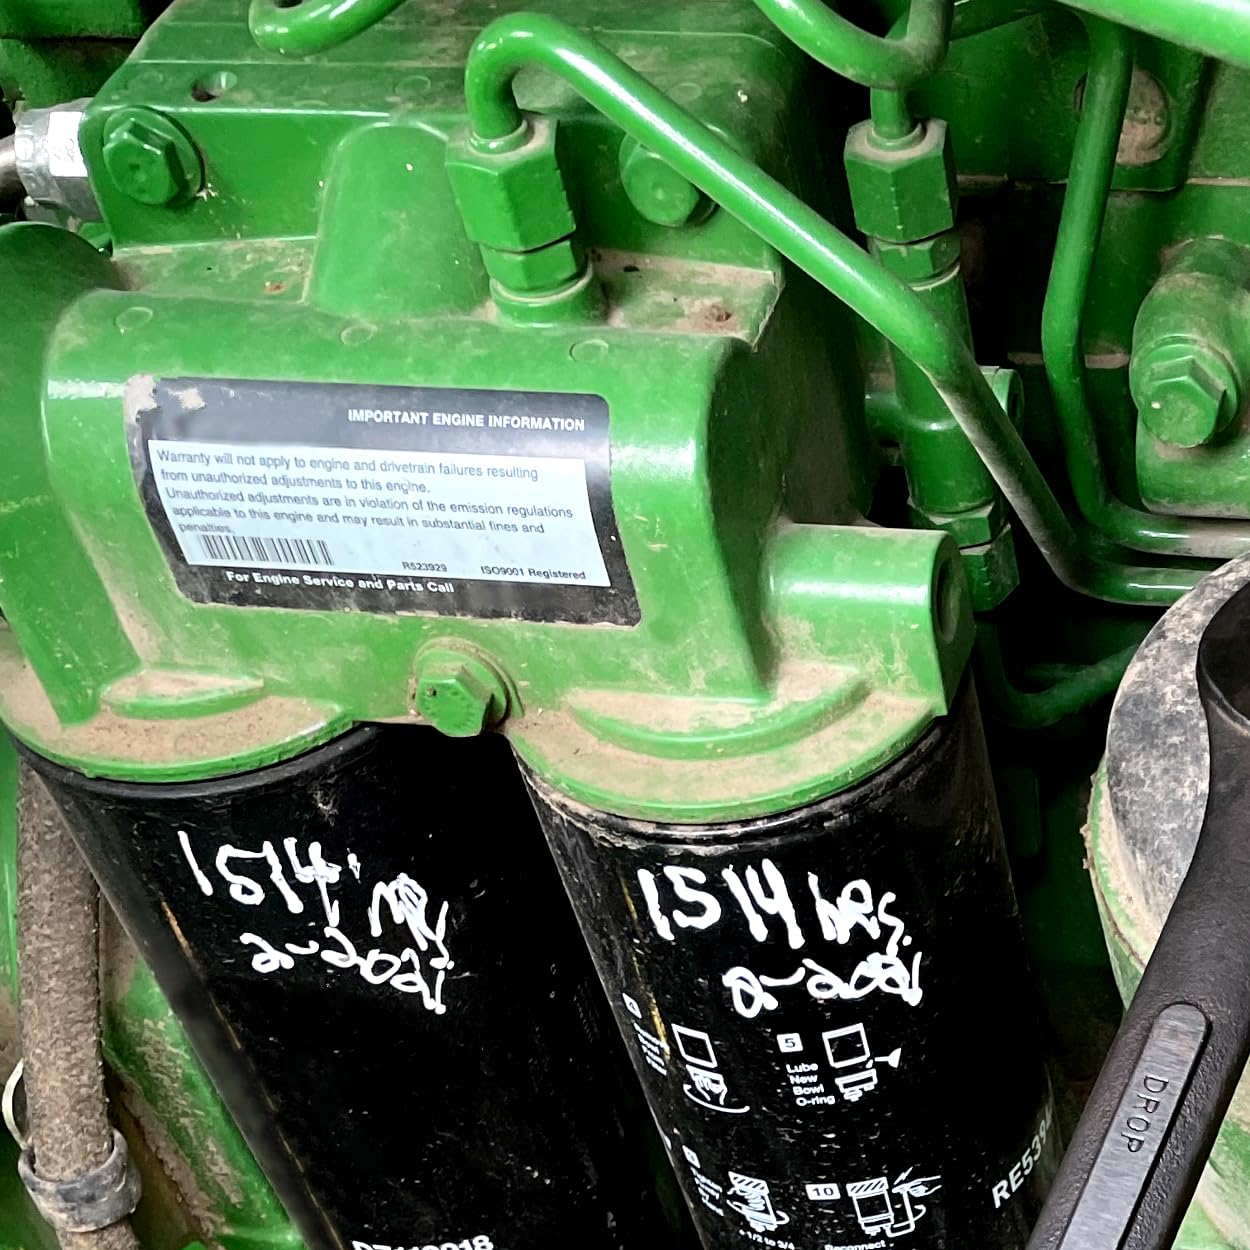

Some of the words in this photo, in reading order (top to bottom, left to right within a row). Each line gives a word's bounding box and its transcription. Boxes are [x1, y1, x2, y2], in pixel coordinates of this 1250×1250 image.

[347, 408, 429, 425] IMPORTANT
[432, 412, 485, 428] ENGINE
[488, 415, 585, 431] INFORMATION
[157, 450, 211, 467] Warranty
[214, 453, 233, 465] will
[237, 454, 255, 466] not
[259, 455, 291, 470] apply
[294, 456, 306, 468] to
[310, 458, 350, 473] engine
[354, 460, 376, 472] and
[380, 460, 436, 475] drivetrain
[439, 462, 483, 476] failures
[487, 465, 539, 482] resulting
[161, 468, 188, 481] from
[192, 470, 267, 485] unauthorized
[272, 475, 342, 490] adjustments
[346, 478, 358, 490] to
[361, 479, 382, 491] this
[386, 480, 431, 495] engine.
[165, 487, 244, 502] Unauthorized
[248, 492, 319, 506] adjustments
[323, 496, 341, 507] are
[346, 495, 356, 507] in
[359, 497, 408, 510] violation
[412, 500, 424, 511] of
[427, 500, 446, 512] the
[450, 501, 504, 515] emission
[507, 505, 573, 519] regulations
[172, 506, 231, 518] applicable
[234, 507, 246, 518] to
[250, 508, 270, 520] this
[274, 511, 313, 523] engine
[317, 512, 339, 523] and
[342, 514, 368, 527] may
[372, 516, 403, 527] result
[407, 517, 418, 527] in
[422, 518, 486, 531] substantial
[489, 520, 518, 532] fines
[522, 523, 545, 533] and
[225, 570, 249, 582] For
[253, 571, 300, 586] Engine
[303, 575, 354, 588] Service
[357, 576, 383, 589] and
[388, 579, 423, 592] Parts
[427, 581, 454, 593] Call
[480, 565, 524, 576] ISO9001
[528, 568, 586, 580] Registered
[784, 1038, 796, 1048] 5
[785, 1062, 819, 1074] Lube
[789, 1074, 818, 1085] New
[792, 1083, 825, 1096] Bowl
[796, 1095, 836, 1107] O-ring
[1120, 1074, 1170, 1154] DROP
[812, 1187, 834, 1196] 10
